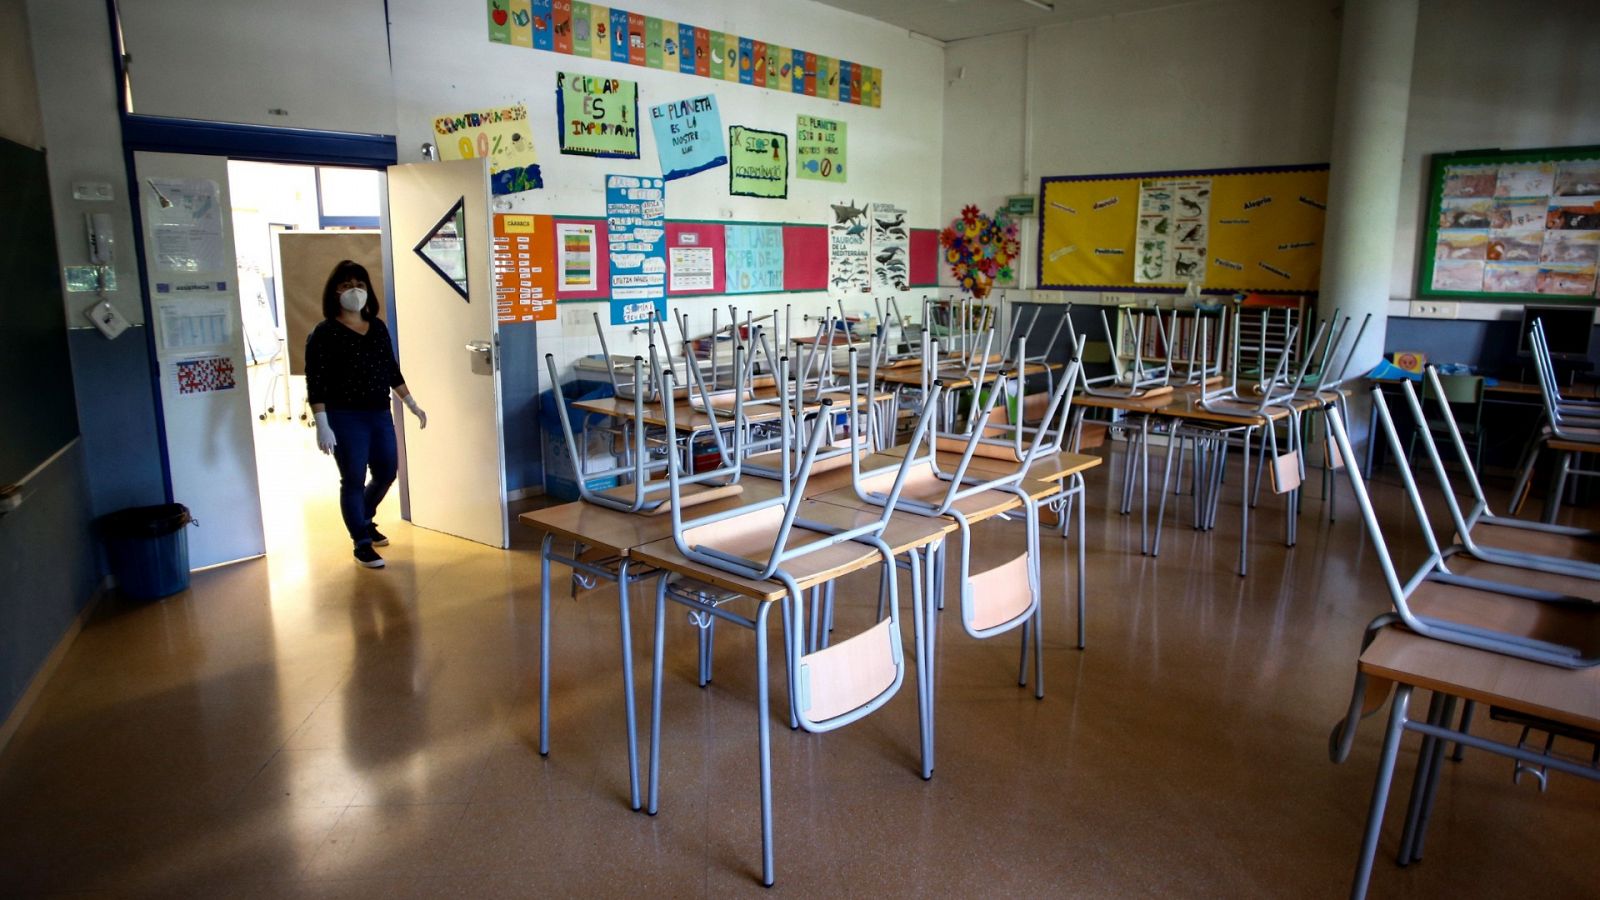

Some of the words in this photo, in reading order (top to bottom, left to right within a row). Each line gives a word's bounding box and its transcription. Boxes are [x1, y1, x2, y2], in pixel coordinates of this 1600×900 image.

[652, 107, 664, 118] EL
[668, 96, 712, 120] PLANETA
[571, 119, 635, 138] IMPORTANT
[686, 116, 696, 128] LA
[810, 117, 838, 131] PLANETA
[746, 136, 769, 150] STOP
[1244, 196, 1272, 210] Alegria
[832, 236, 864, 244] TAURONS
